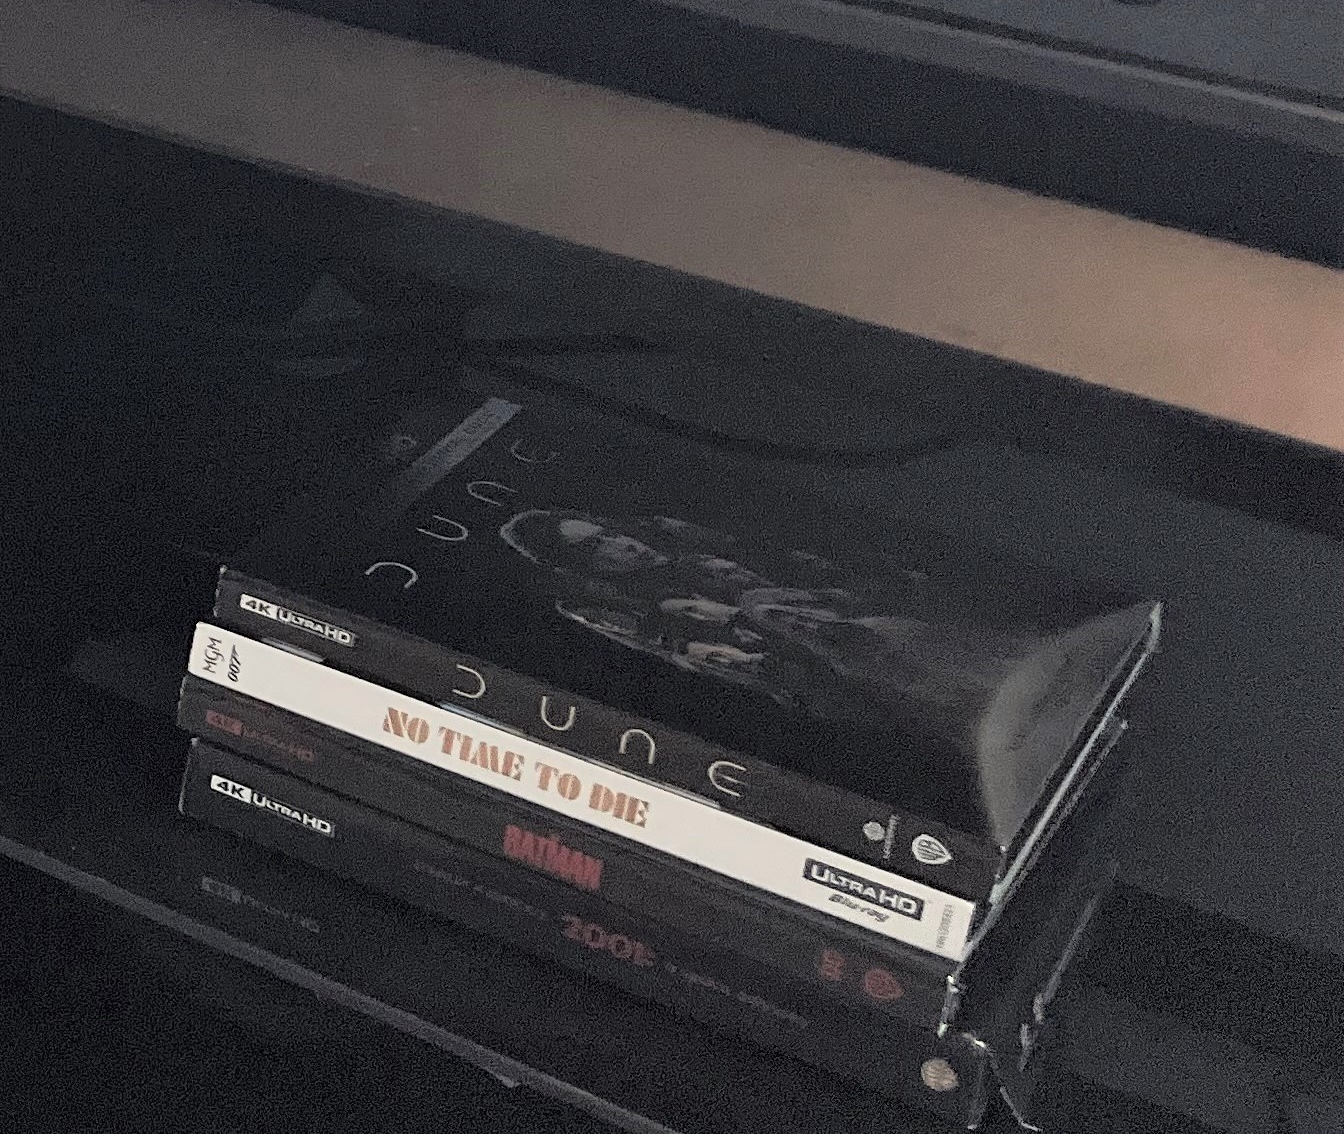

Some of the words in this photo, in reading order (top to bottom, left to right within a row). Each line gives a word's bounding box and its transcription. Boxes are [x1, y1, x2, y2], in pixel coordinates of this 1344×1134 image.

[243, 597, 273, 618] 4K
[202, 636, 225, 674] MGM
[227, 644, 242, 683] 007
[382, 707, 430, 744] NO
[438, 726, 525, 781] TIME
[536, 761, 582, 801] TO
[588, 783, 650, 828] DIE
[214, 778, 248, 801] 4K
